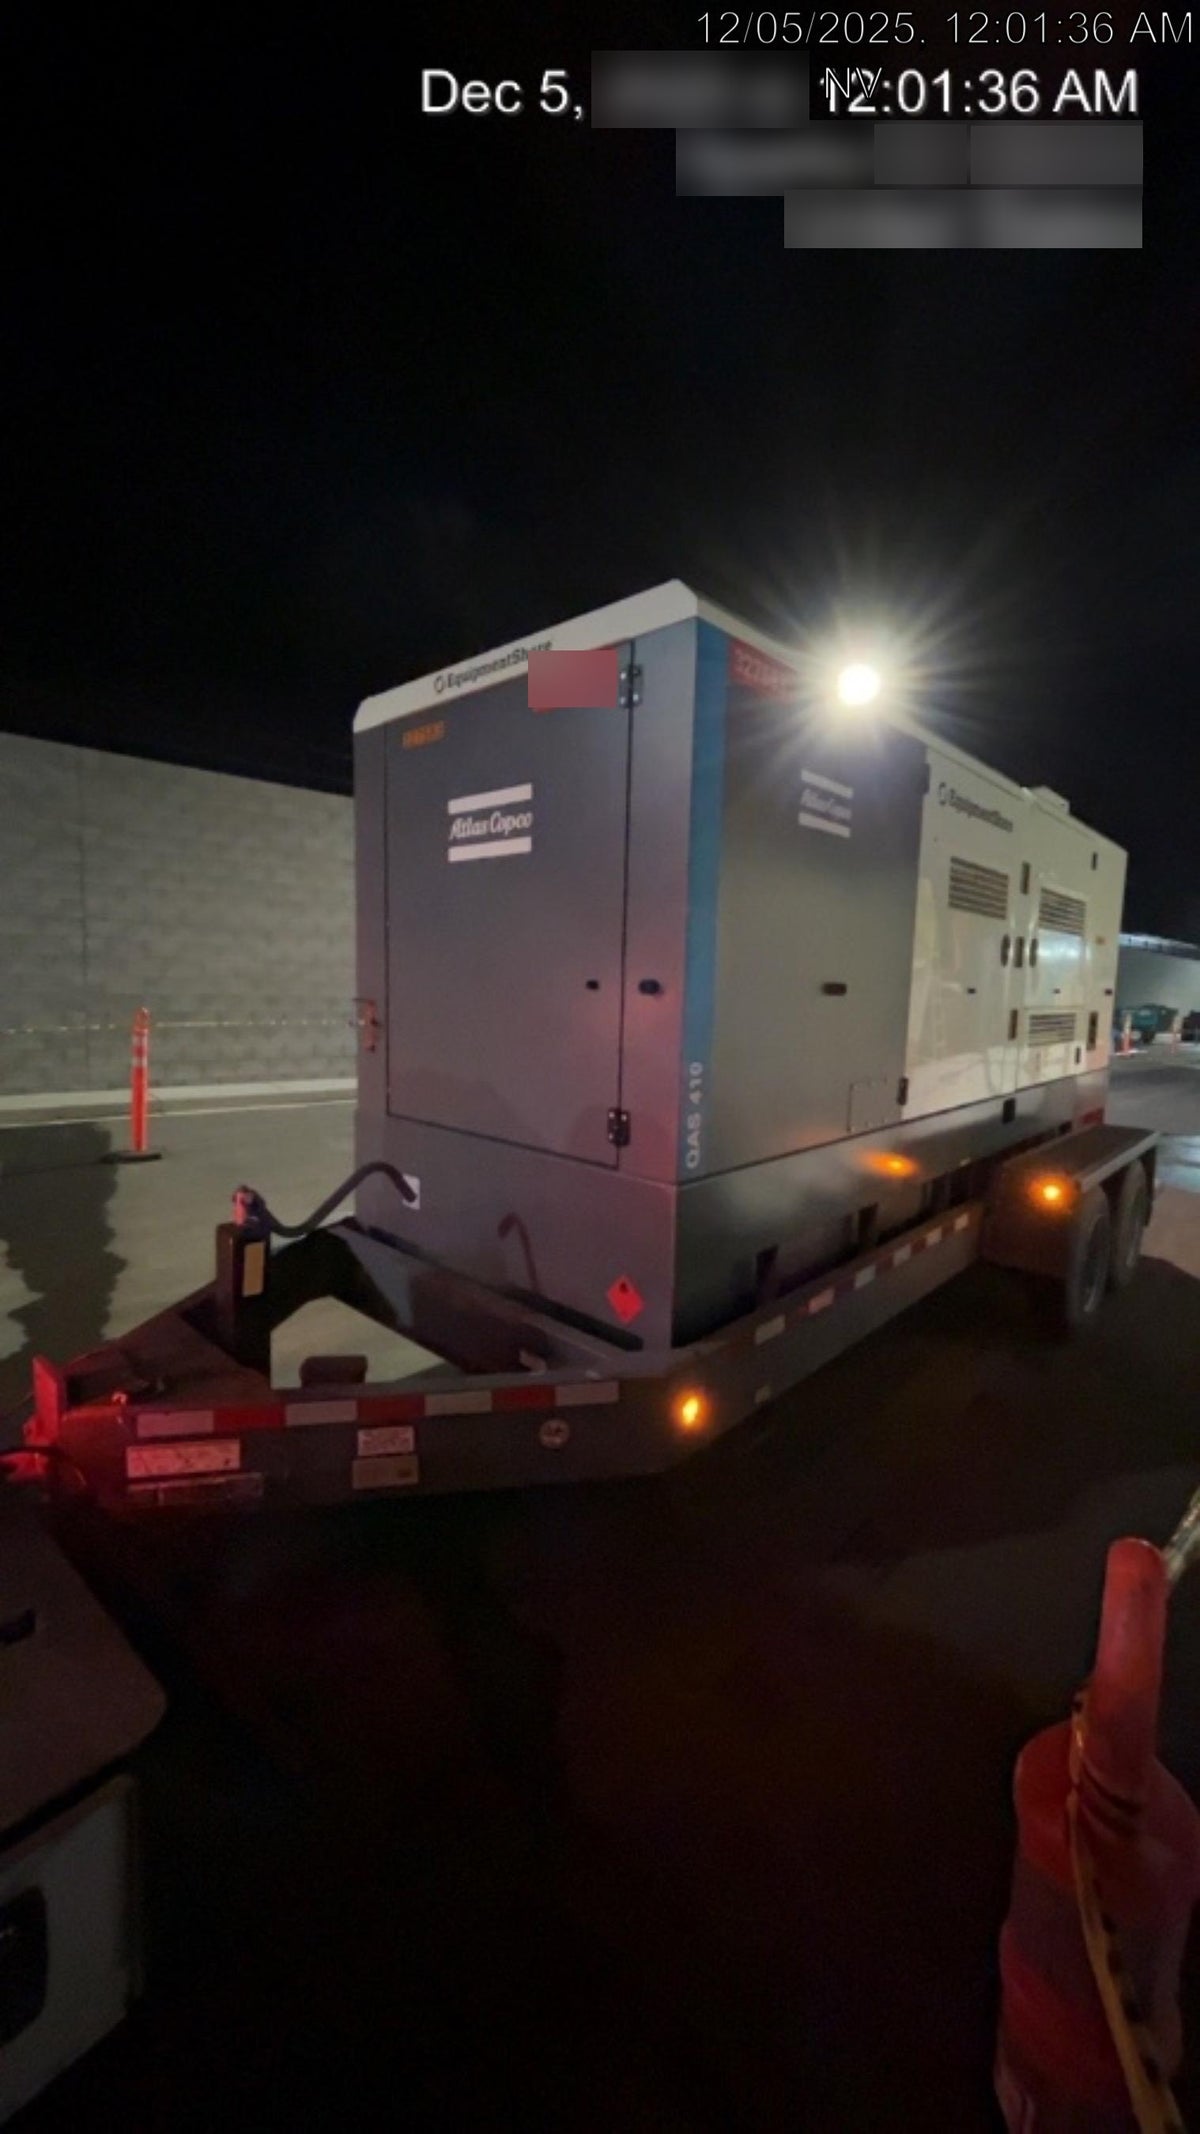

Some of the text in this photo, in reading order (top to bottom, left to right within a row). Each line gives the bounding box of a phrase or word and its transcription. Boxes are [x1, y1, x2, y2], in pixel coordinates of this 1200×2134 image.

[448, 810, 534, 841] Atlas Copco
[685, 1060, 704, 1170] QAS 410
